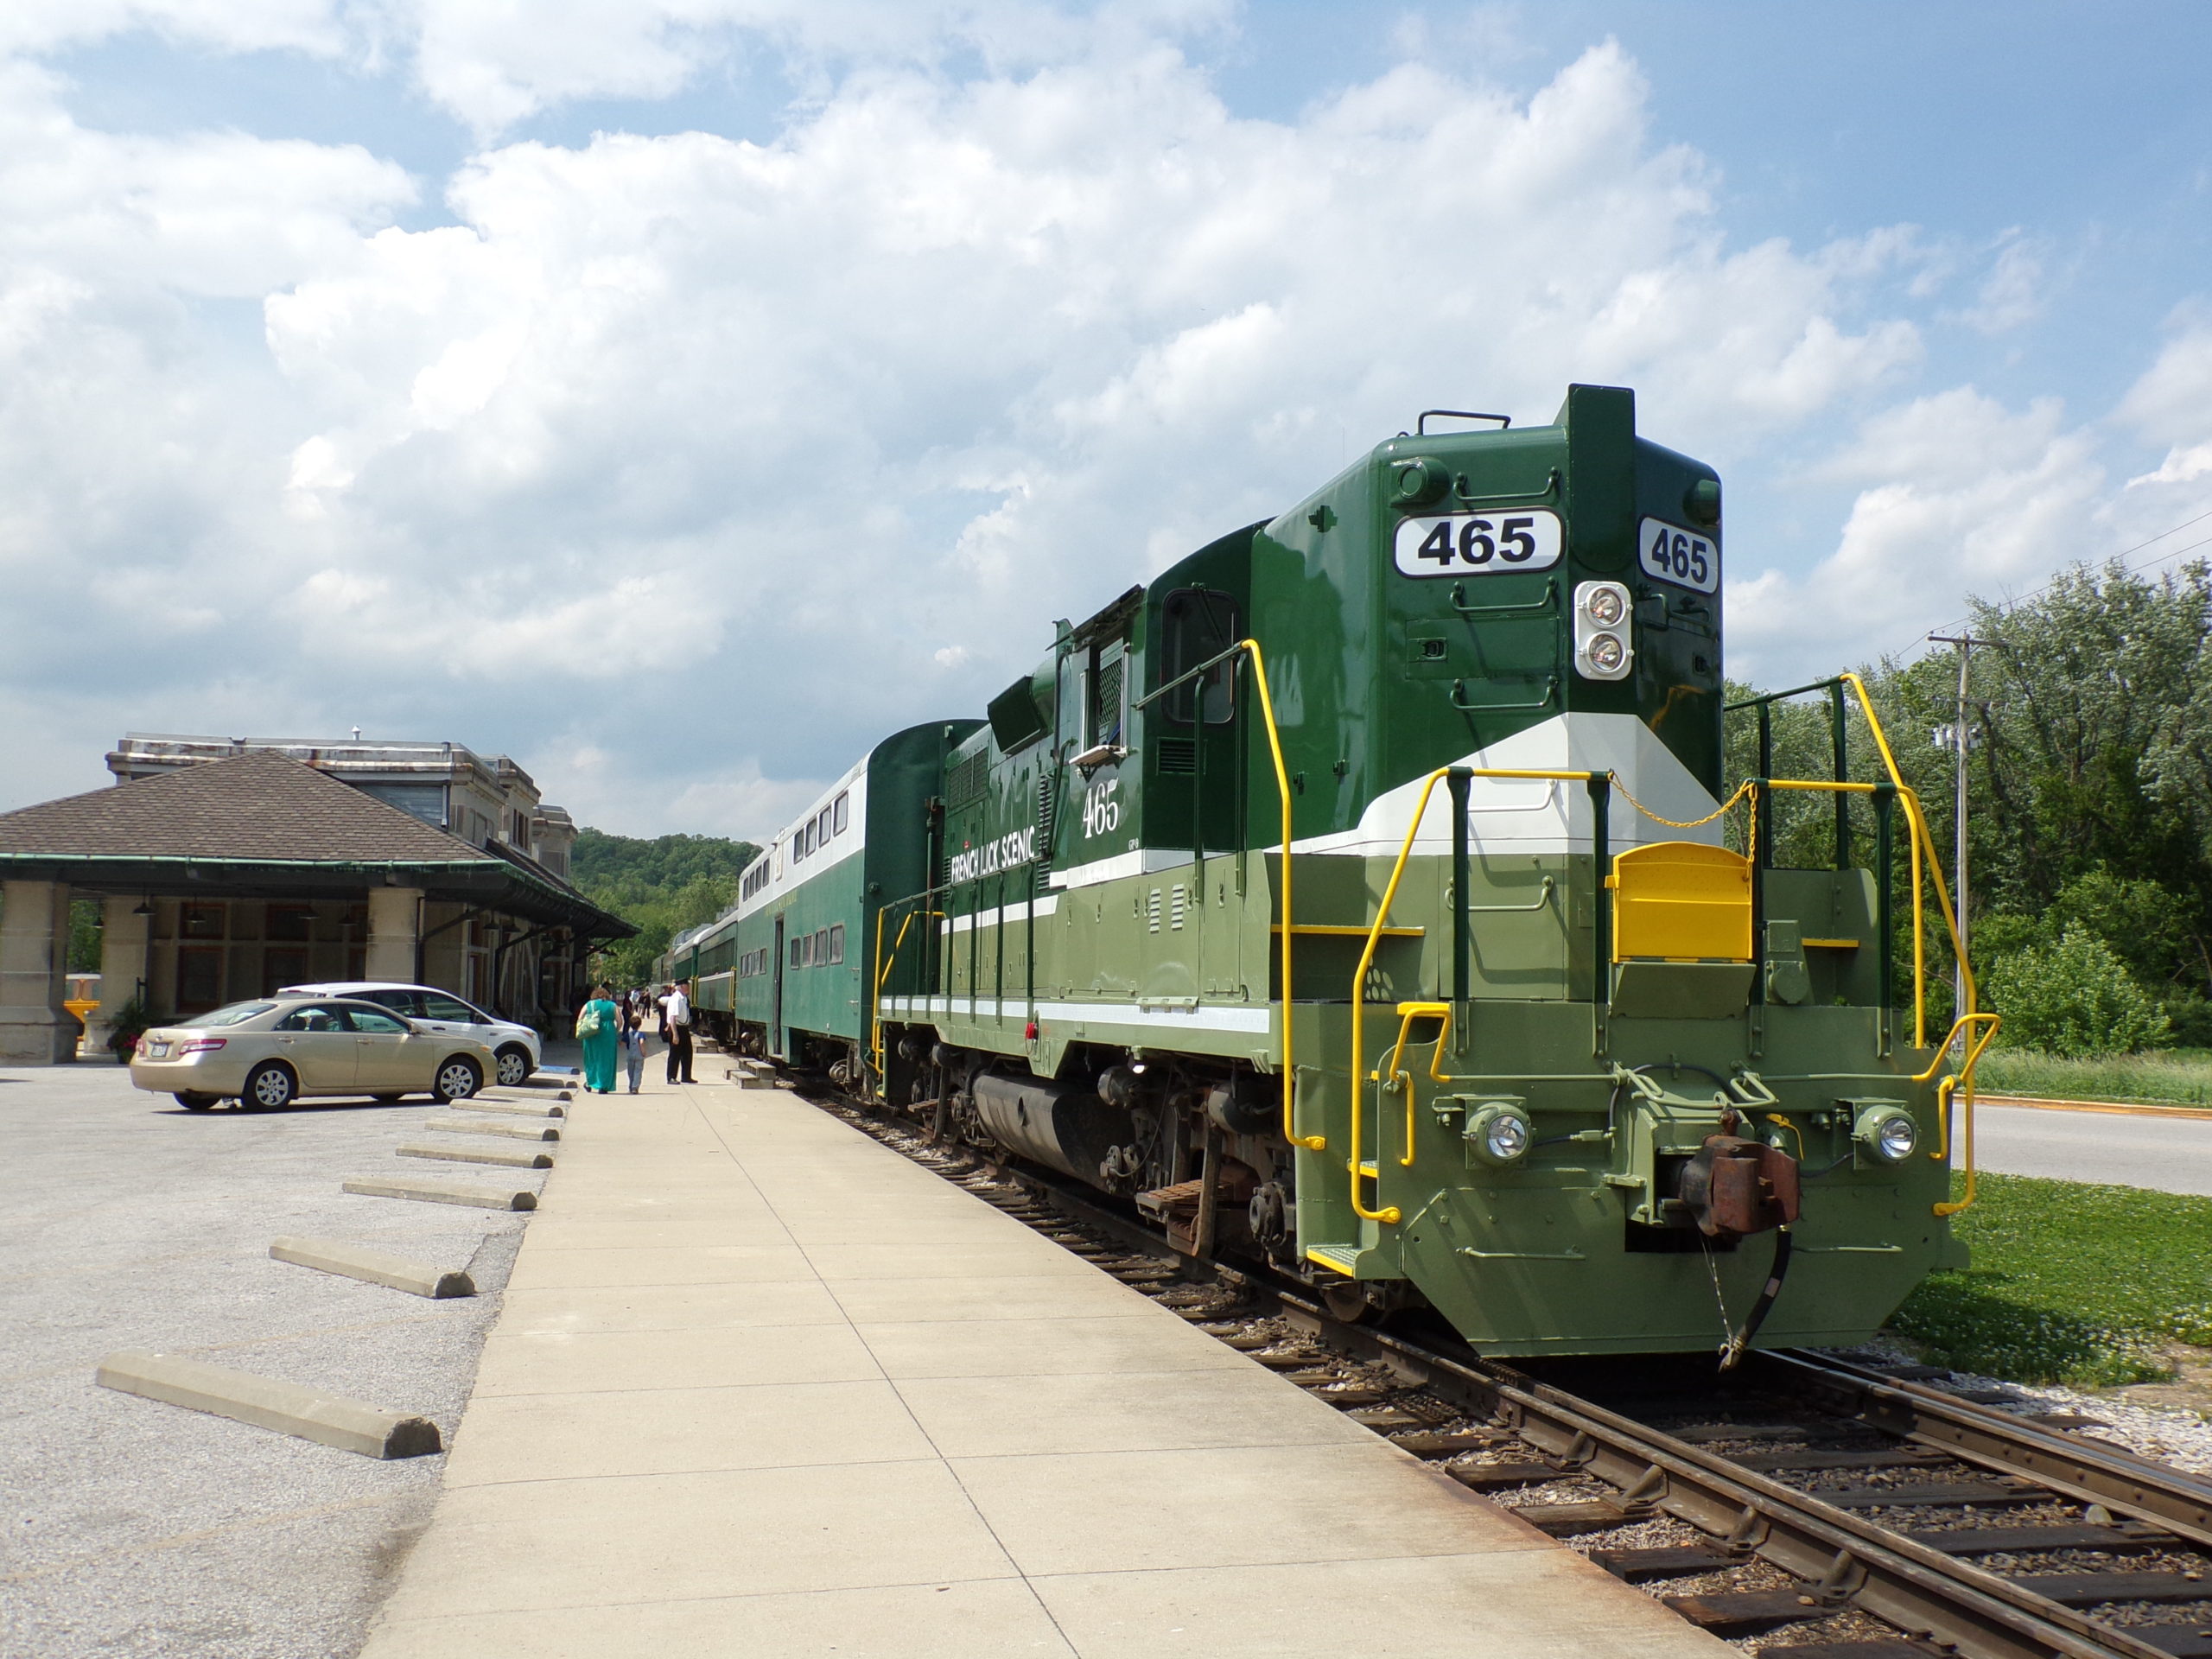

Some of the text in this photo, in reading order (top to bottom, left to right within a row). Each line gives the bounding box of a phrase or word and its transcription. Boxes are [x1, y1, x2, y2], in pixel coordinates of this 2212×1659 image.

[1418, 518, 1535, 566] 465
[1651, 528, 1708, 583] 465
[1083, 777, 1118, 839] 465
[951, 824, 1035, 883] FRENCH LICK SCENIC
